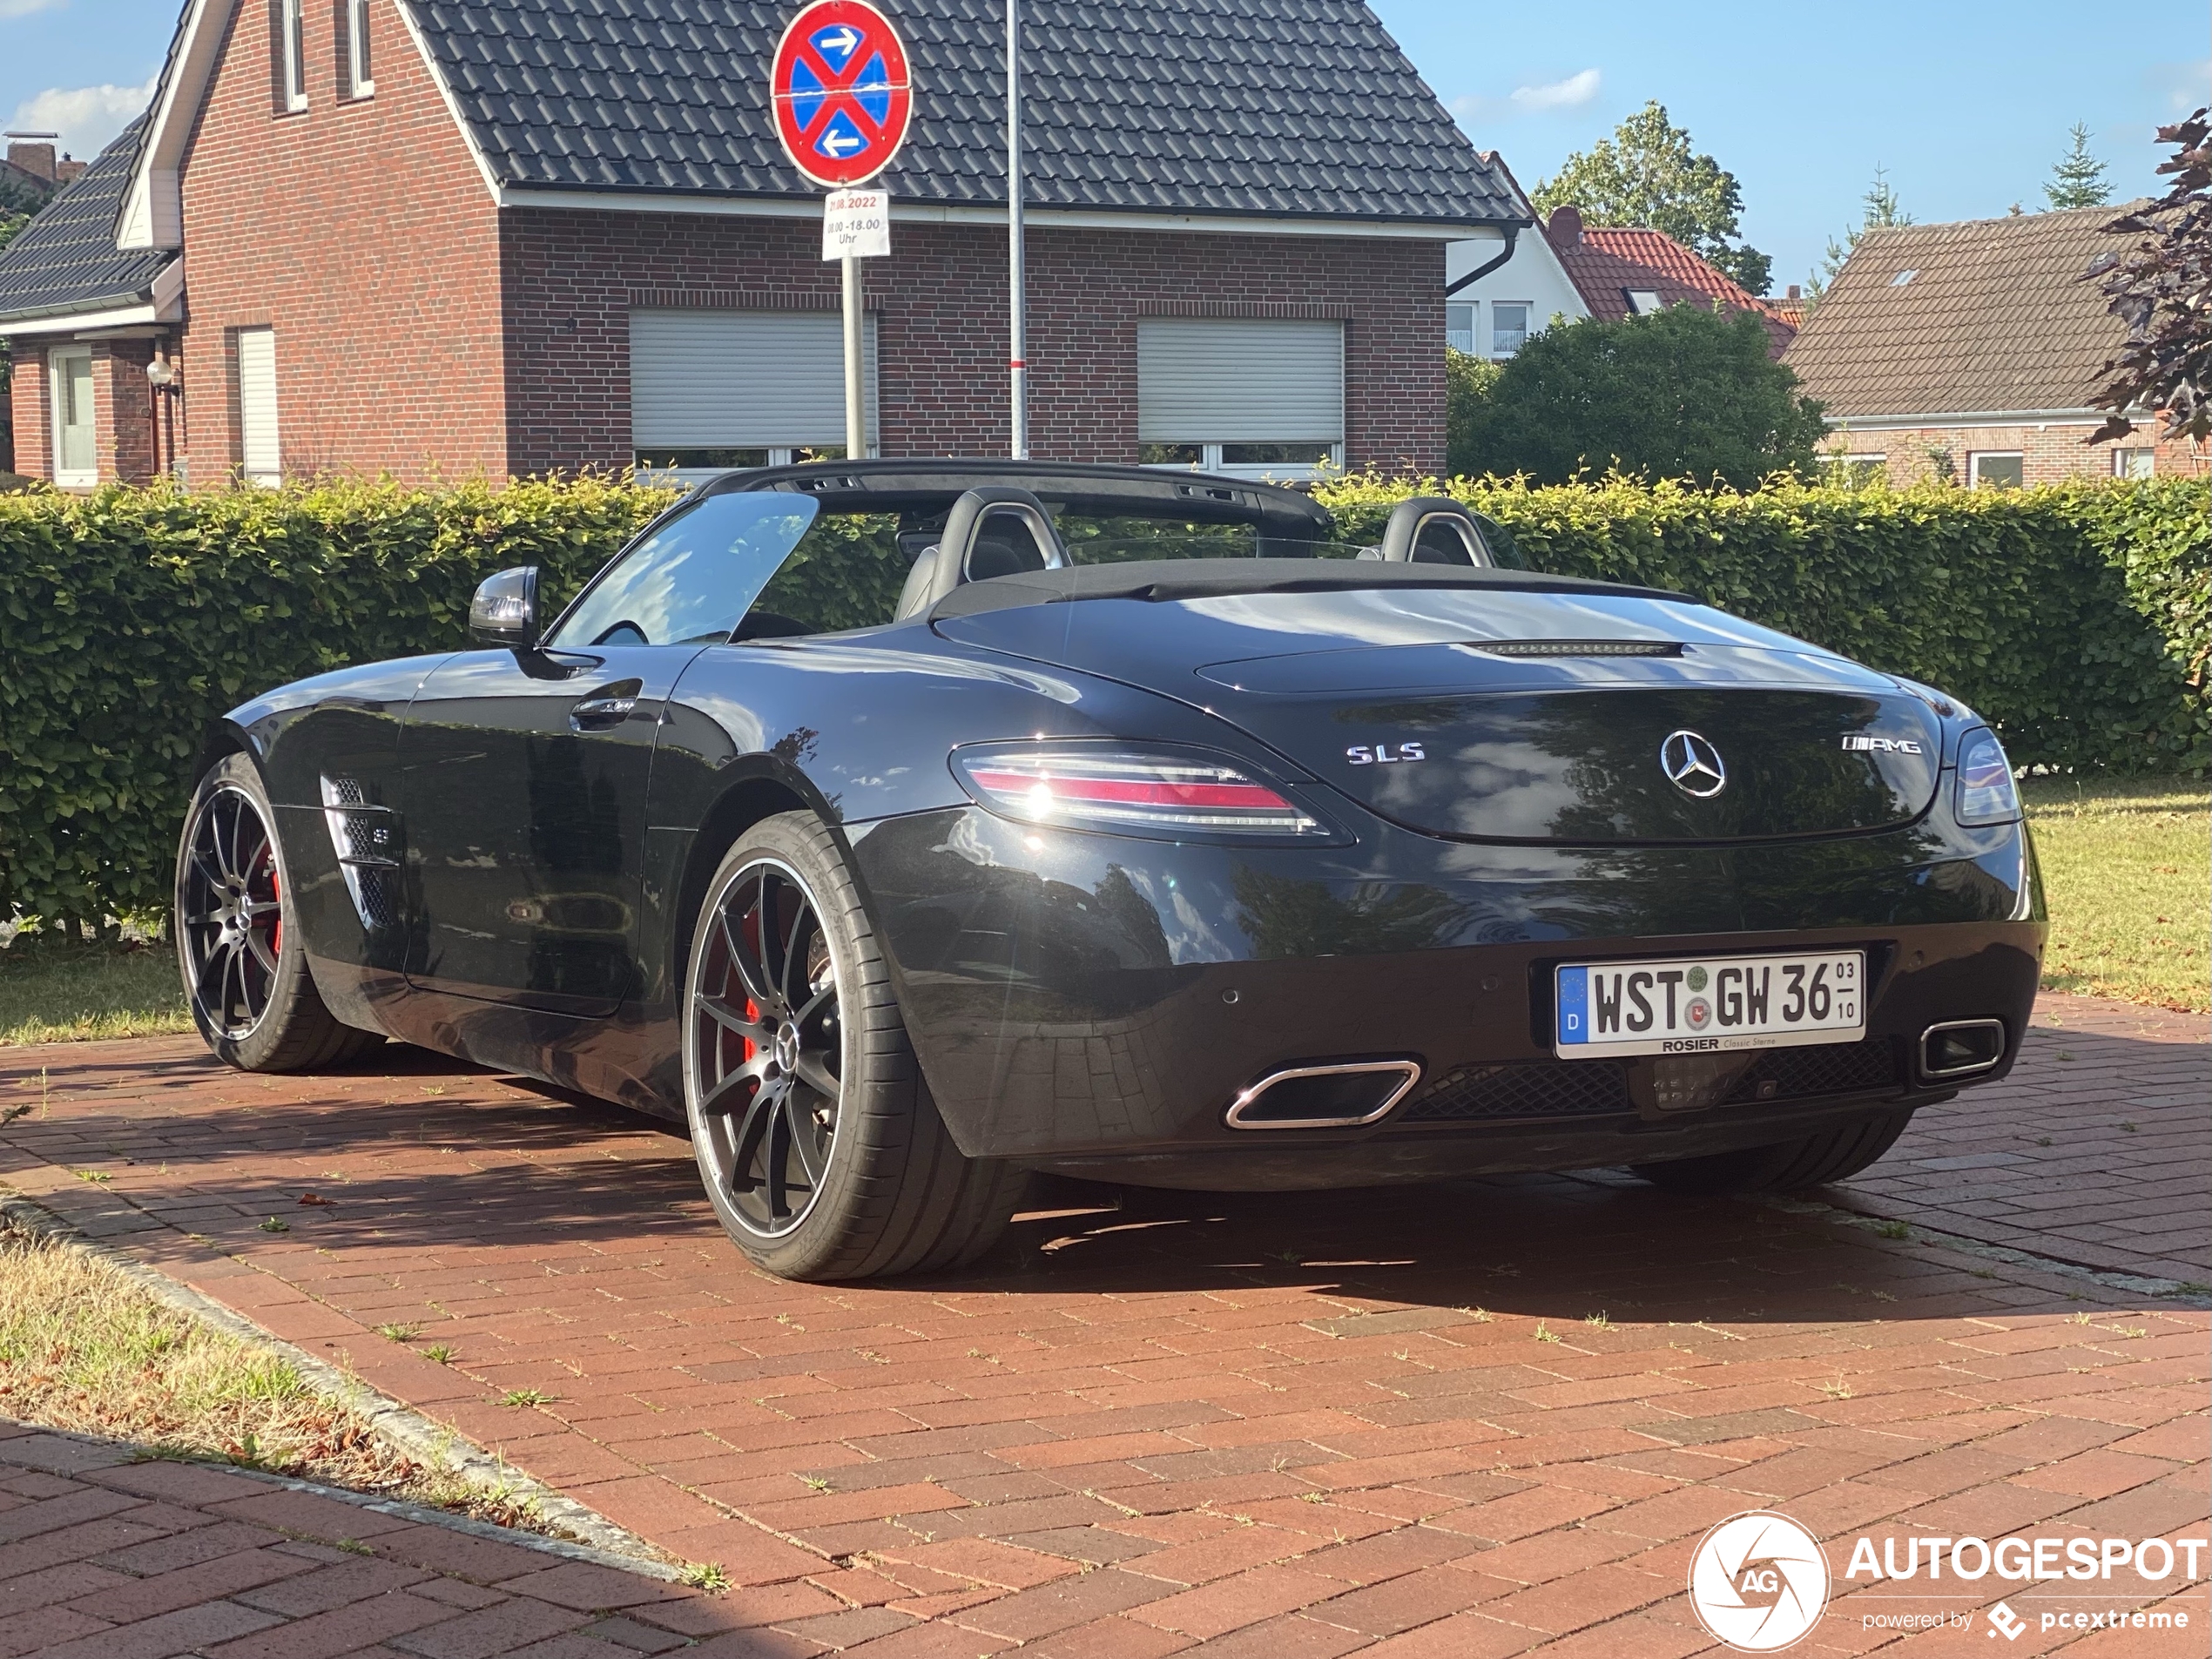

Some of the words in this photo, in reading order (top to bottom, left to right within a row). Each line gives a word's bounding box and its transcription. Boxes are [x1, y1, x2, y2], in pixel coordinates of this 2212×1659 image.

[830, 197, 876, 212] 21.08.2022
[839, 233, 857, 244] Uhr
[1346, 742, 1425, 765] SLS
[1869, 737, 1922, 754] AMG
[1837, 962, 1854, 978] 03
[1595, 970, 1683, 1033] WST
[1716, 966, 1770, 1026] GW
[1783, 963, 1831, 1022] 36
[1838, 1002, 1854, 1019] 10
[1568, 1014, 1579, 1030] D
[1662, 1039, 1719, 1052] ROSIER
[1724, 1039, 1750, 1048] Classic
[1752, 1037, 1776, 1046] Sterne
